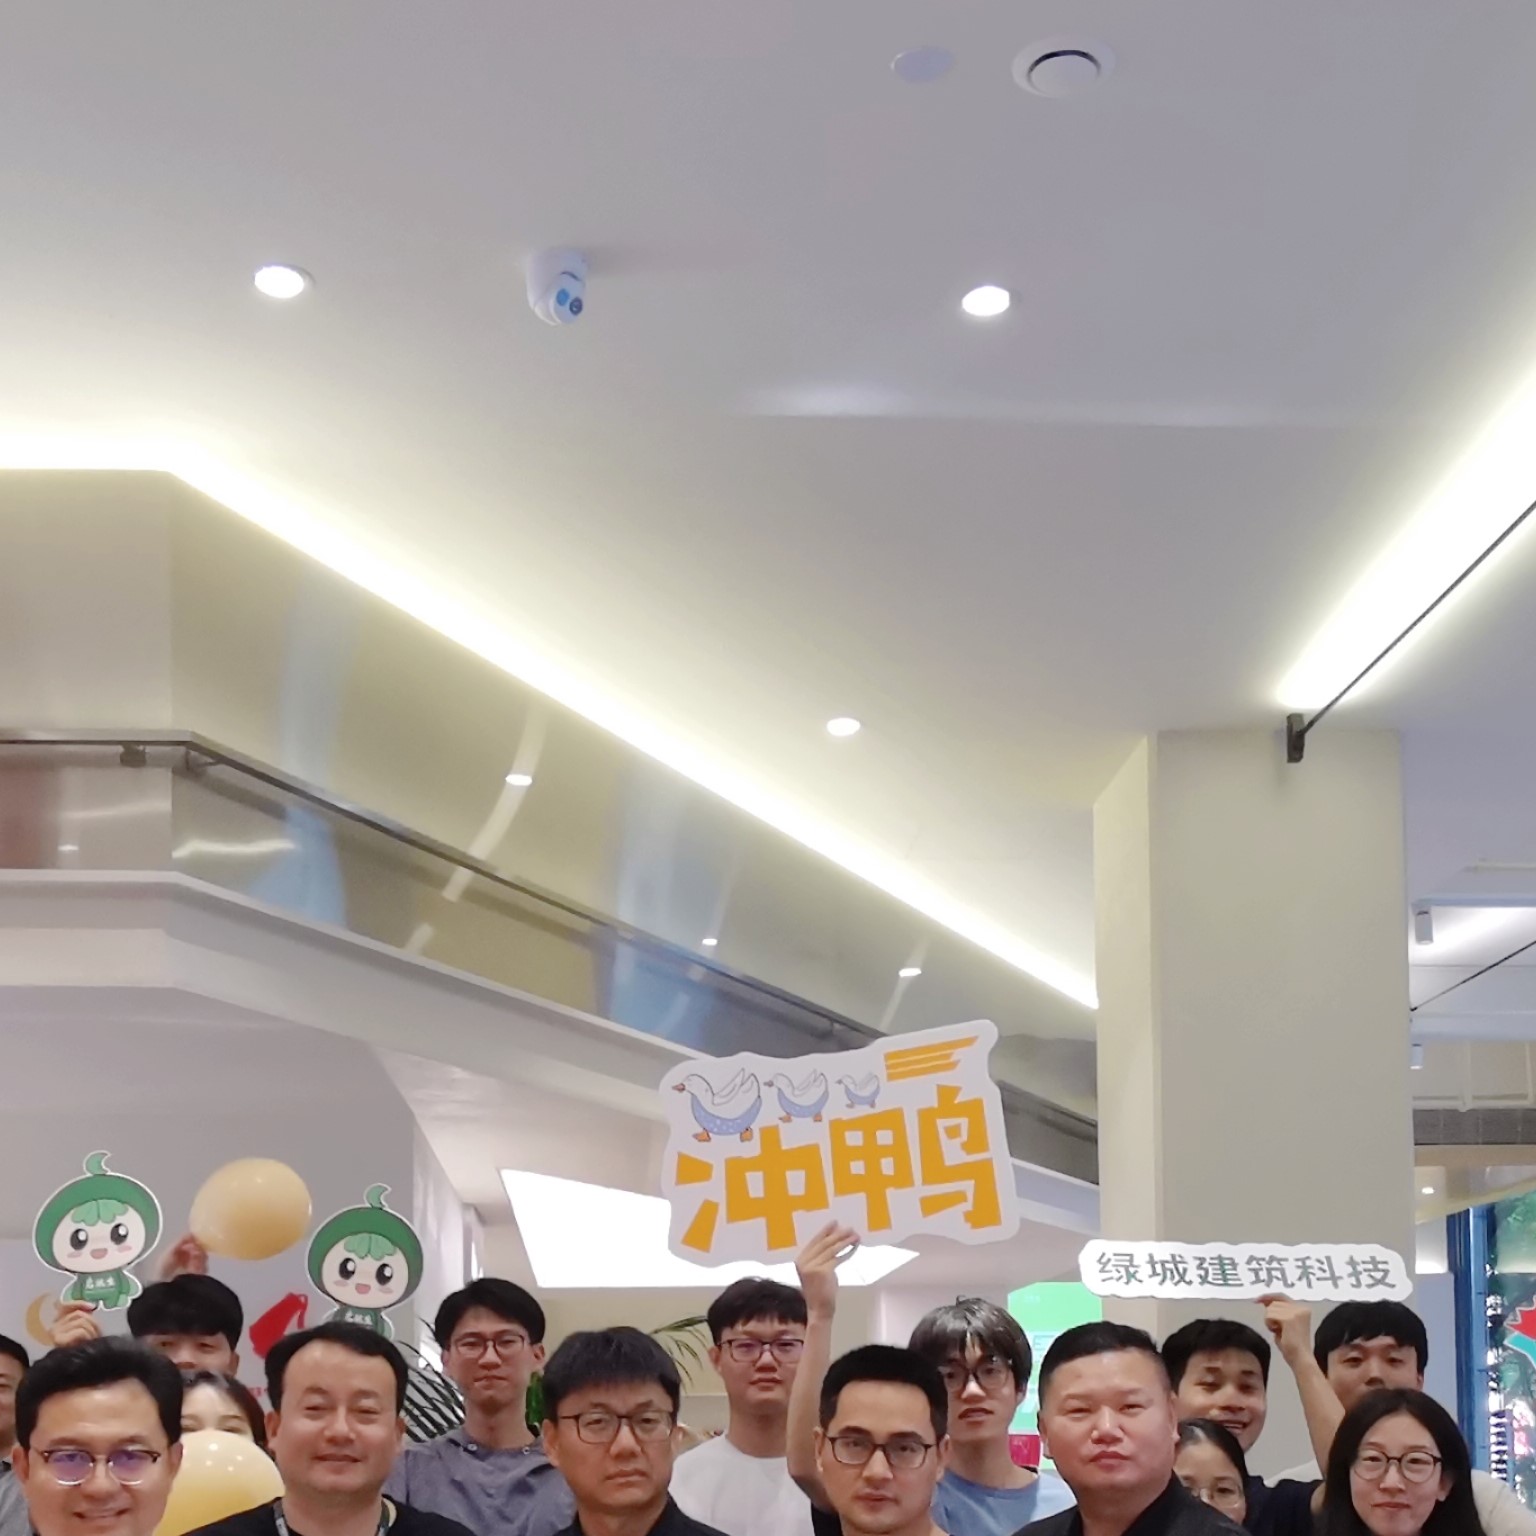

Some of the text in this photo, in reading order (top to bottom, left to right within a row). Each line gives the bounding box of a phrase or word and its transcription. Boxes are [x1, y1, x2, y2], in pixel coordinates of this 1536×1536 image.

[675, 1084, 1002, 1254] 冲鸭
[1096, 1251, 1398, 1291] 绿城建筑科技
